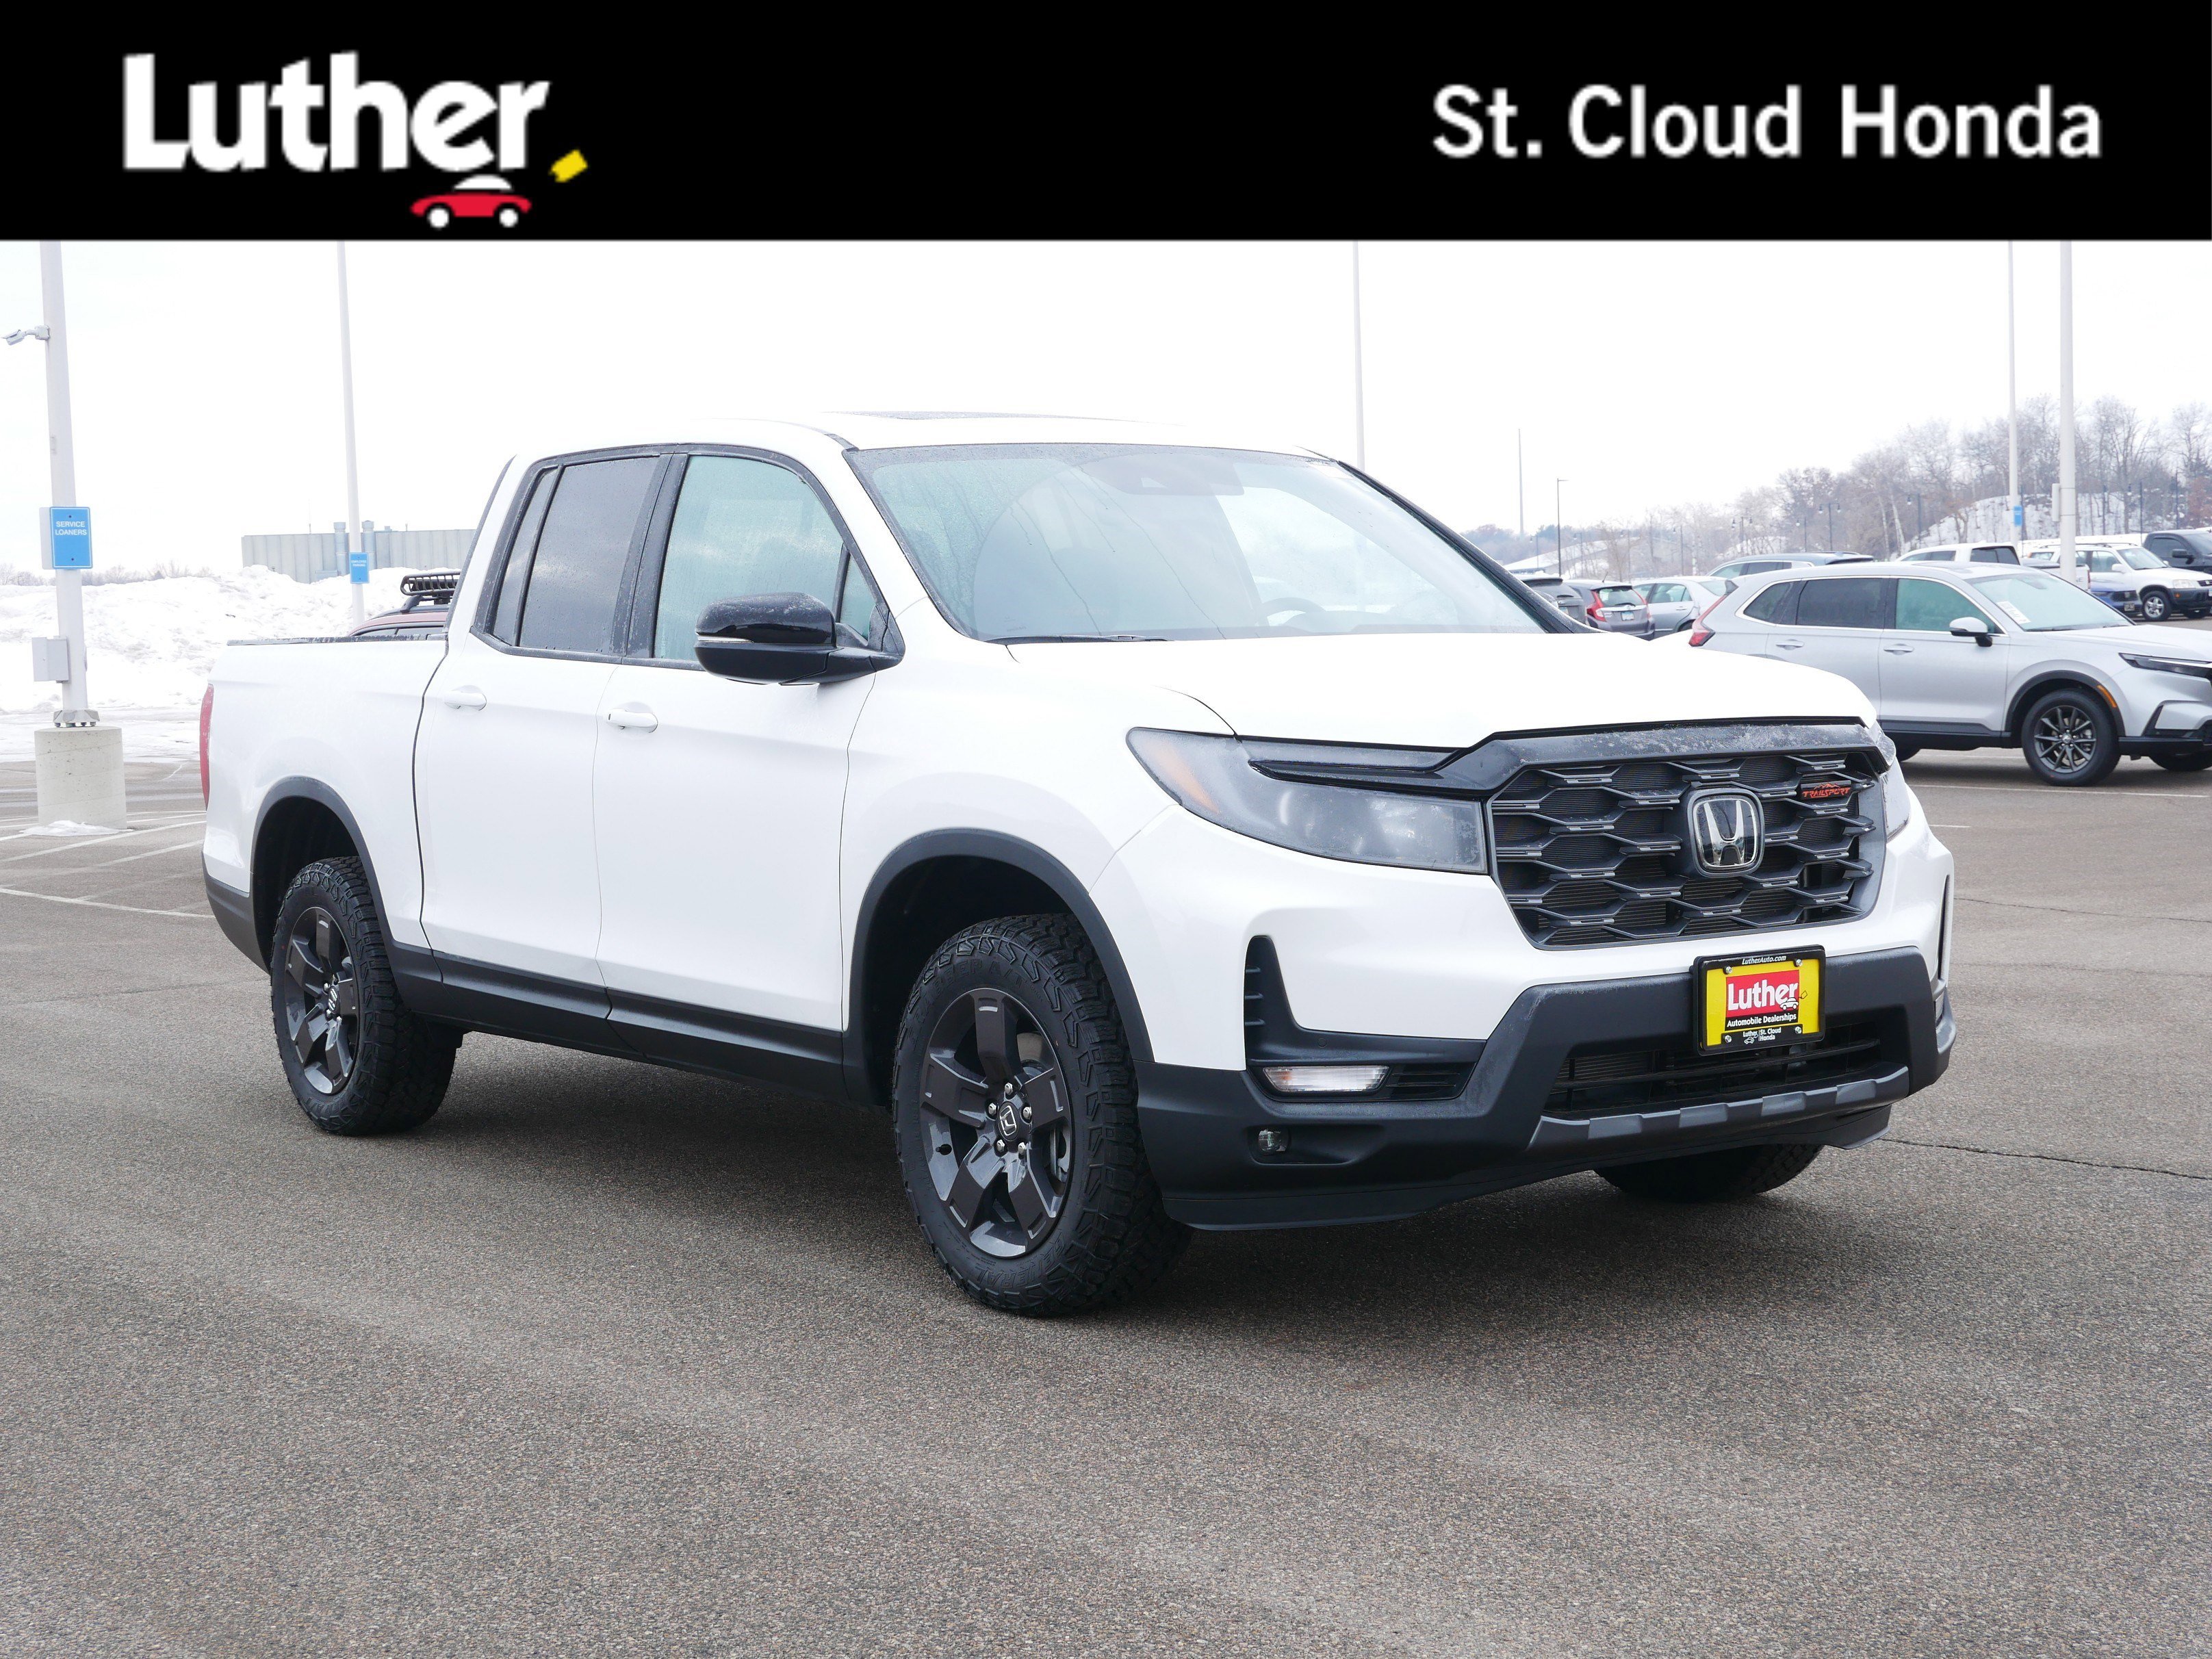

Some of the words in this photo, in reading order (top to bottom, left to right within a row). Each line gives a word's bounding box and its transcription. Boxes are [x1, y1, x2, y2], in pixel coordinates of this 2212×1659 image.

[1802, 787, 1851, 799] TRAILSPORT
[1741, 955, 1786, 965] LutherAuto.com
[1727, 979, 1799, 1011] Luther
[1727, 1016, 1762, 1027] Automobile
[1763, 1013, 1797, 1023] Dealerships
